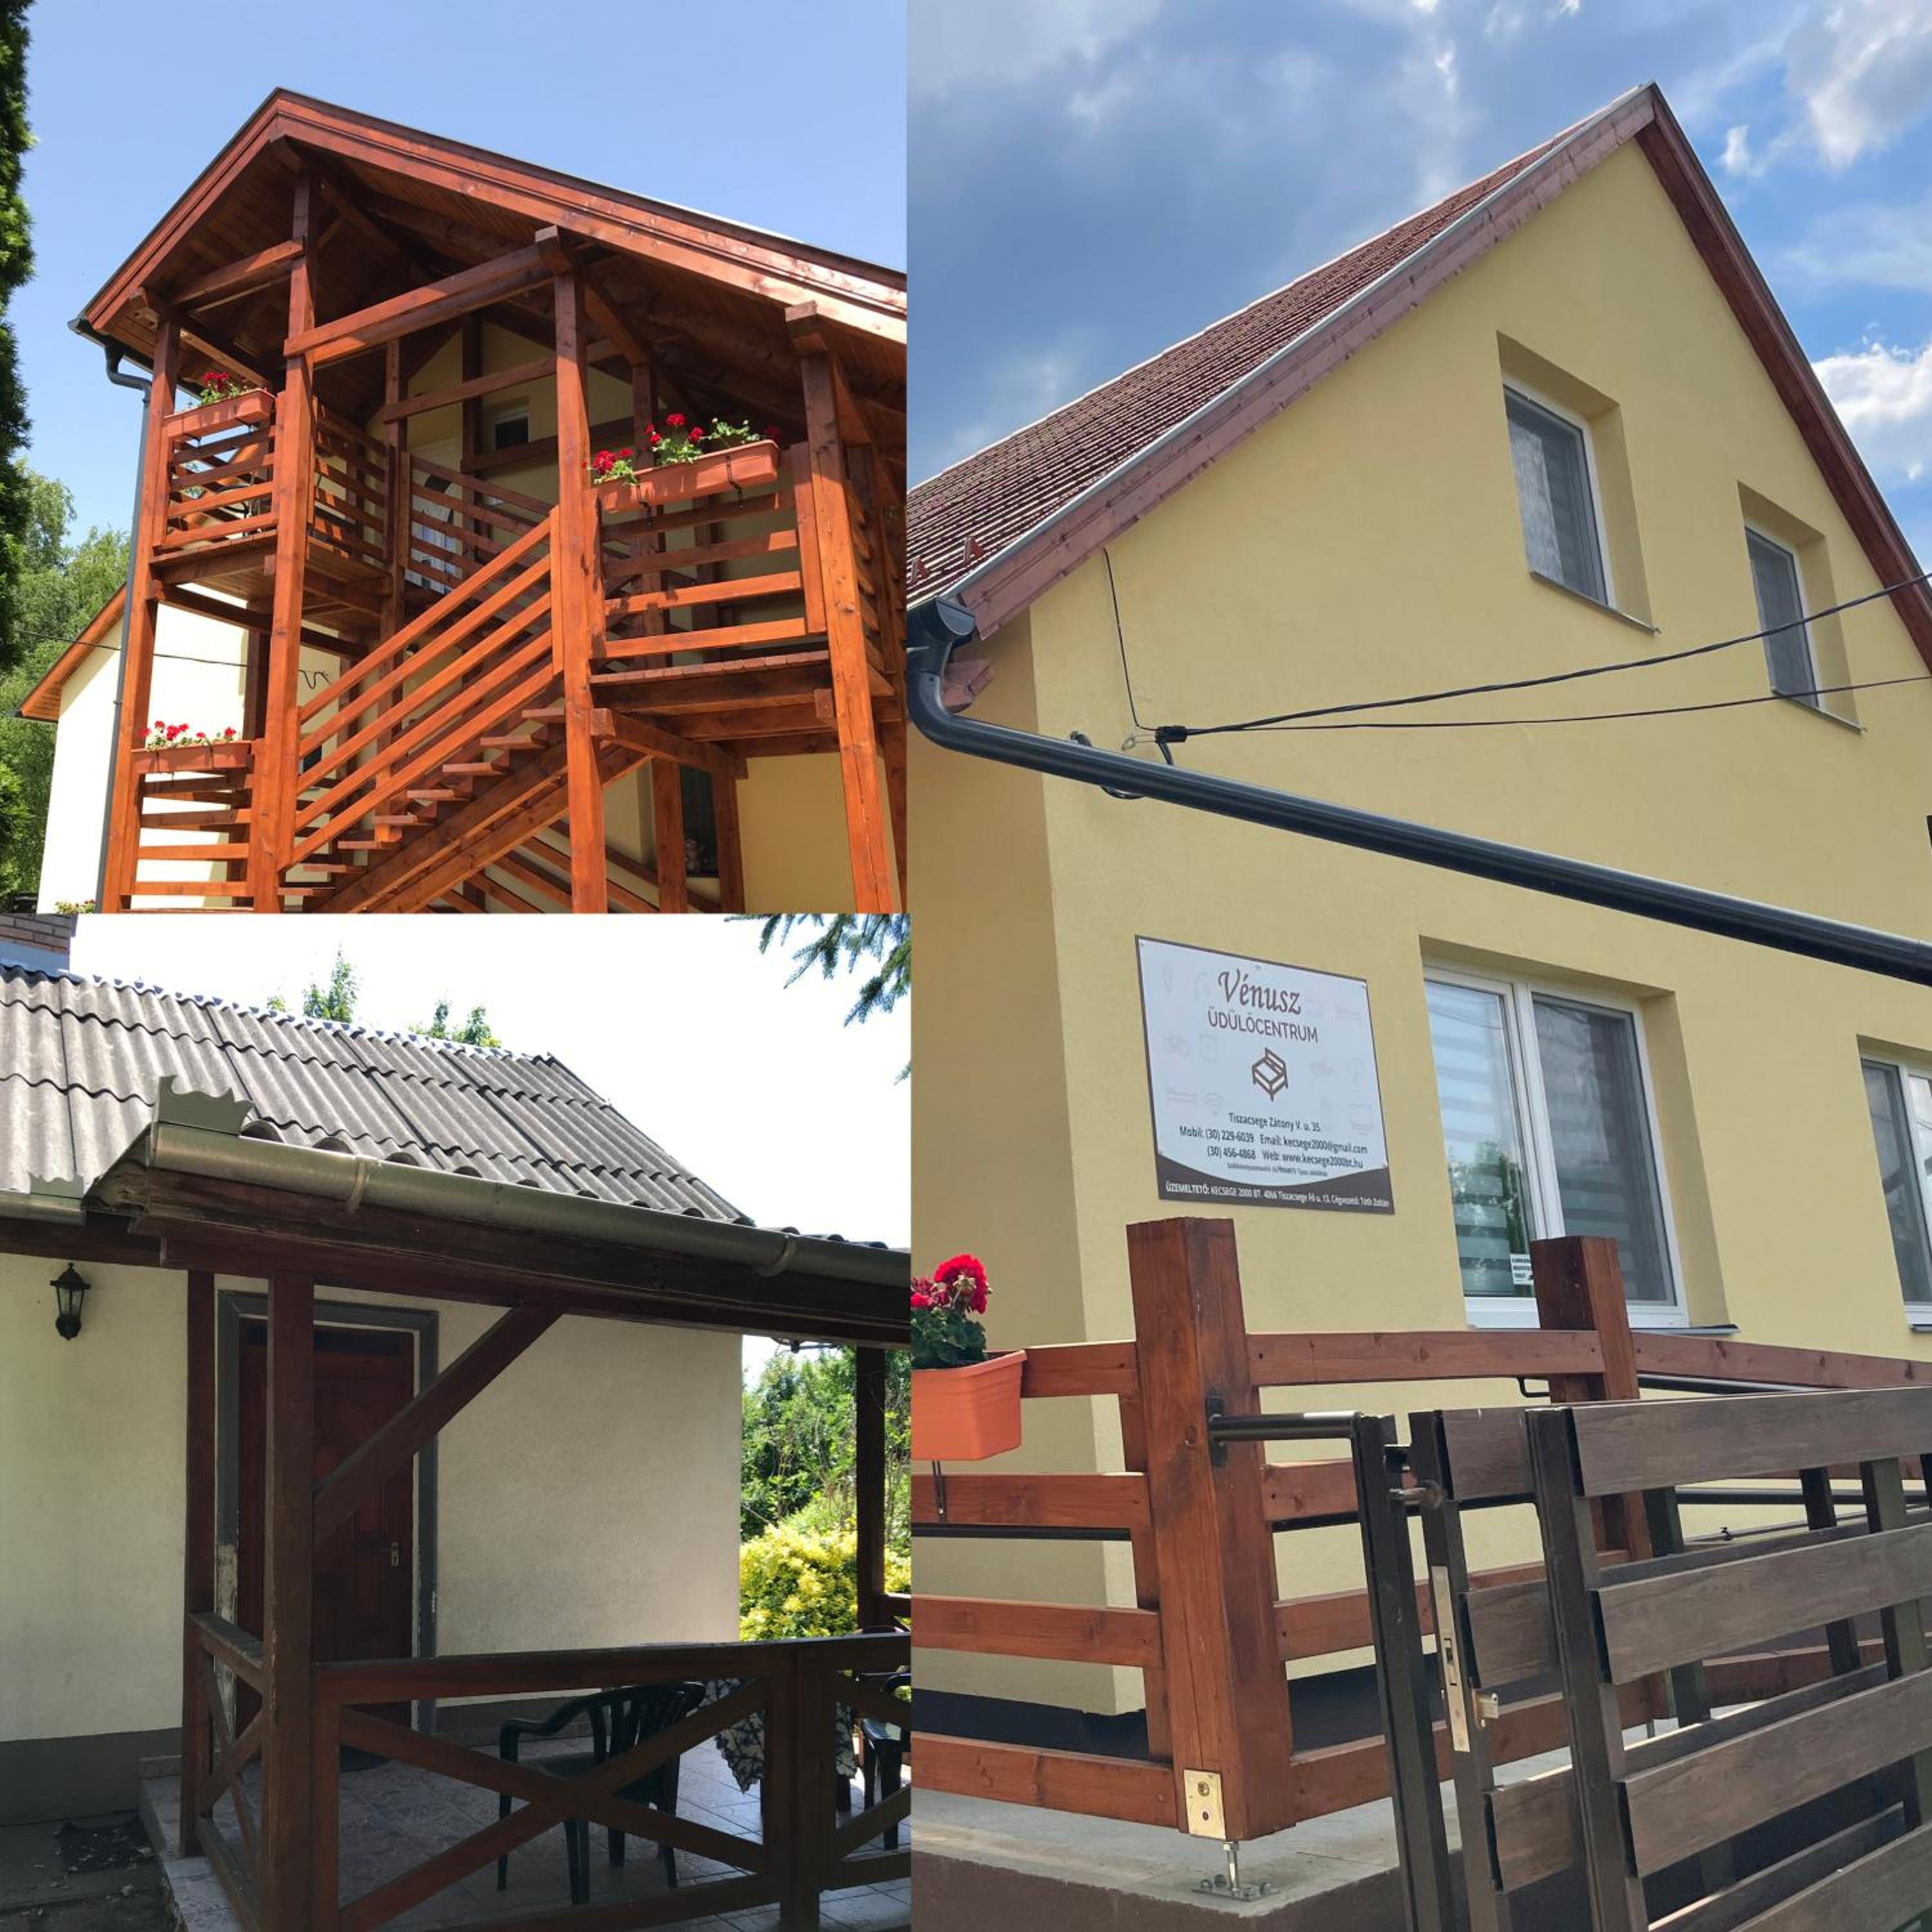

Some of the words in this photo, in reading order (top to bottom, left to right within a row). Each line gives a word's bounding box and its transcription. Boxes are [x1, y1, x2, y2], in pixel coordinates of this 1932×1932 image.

[1218, 968, 1301, 1015] Vénusz
[1228, 1112, 1267, 1129] Tiszacsege
[1179, 1125, 1204, 1138] Mobil:
[1205, 1128, 1220, 1141] (30)
[1222, 1130, 1254, 1143] 229-6039
[1260, 1133, 1282, 1146] Email:
[1207, 1146, 1222, 1159] (30)
[1223, 1147, 1256, 1160] 456-4868
[1262, 1150, 1280, 1162] Web:
[1210, 1186, 1237, 1197] KECSEGE
[1238, 1188, 1253, 1198] 2000
